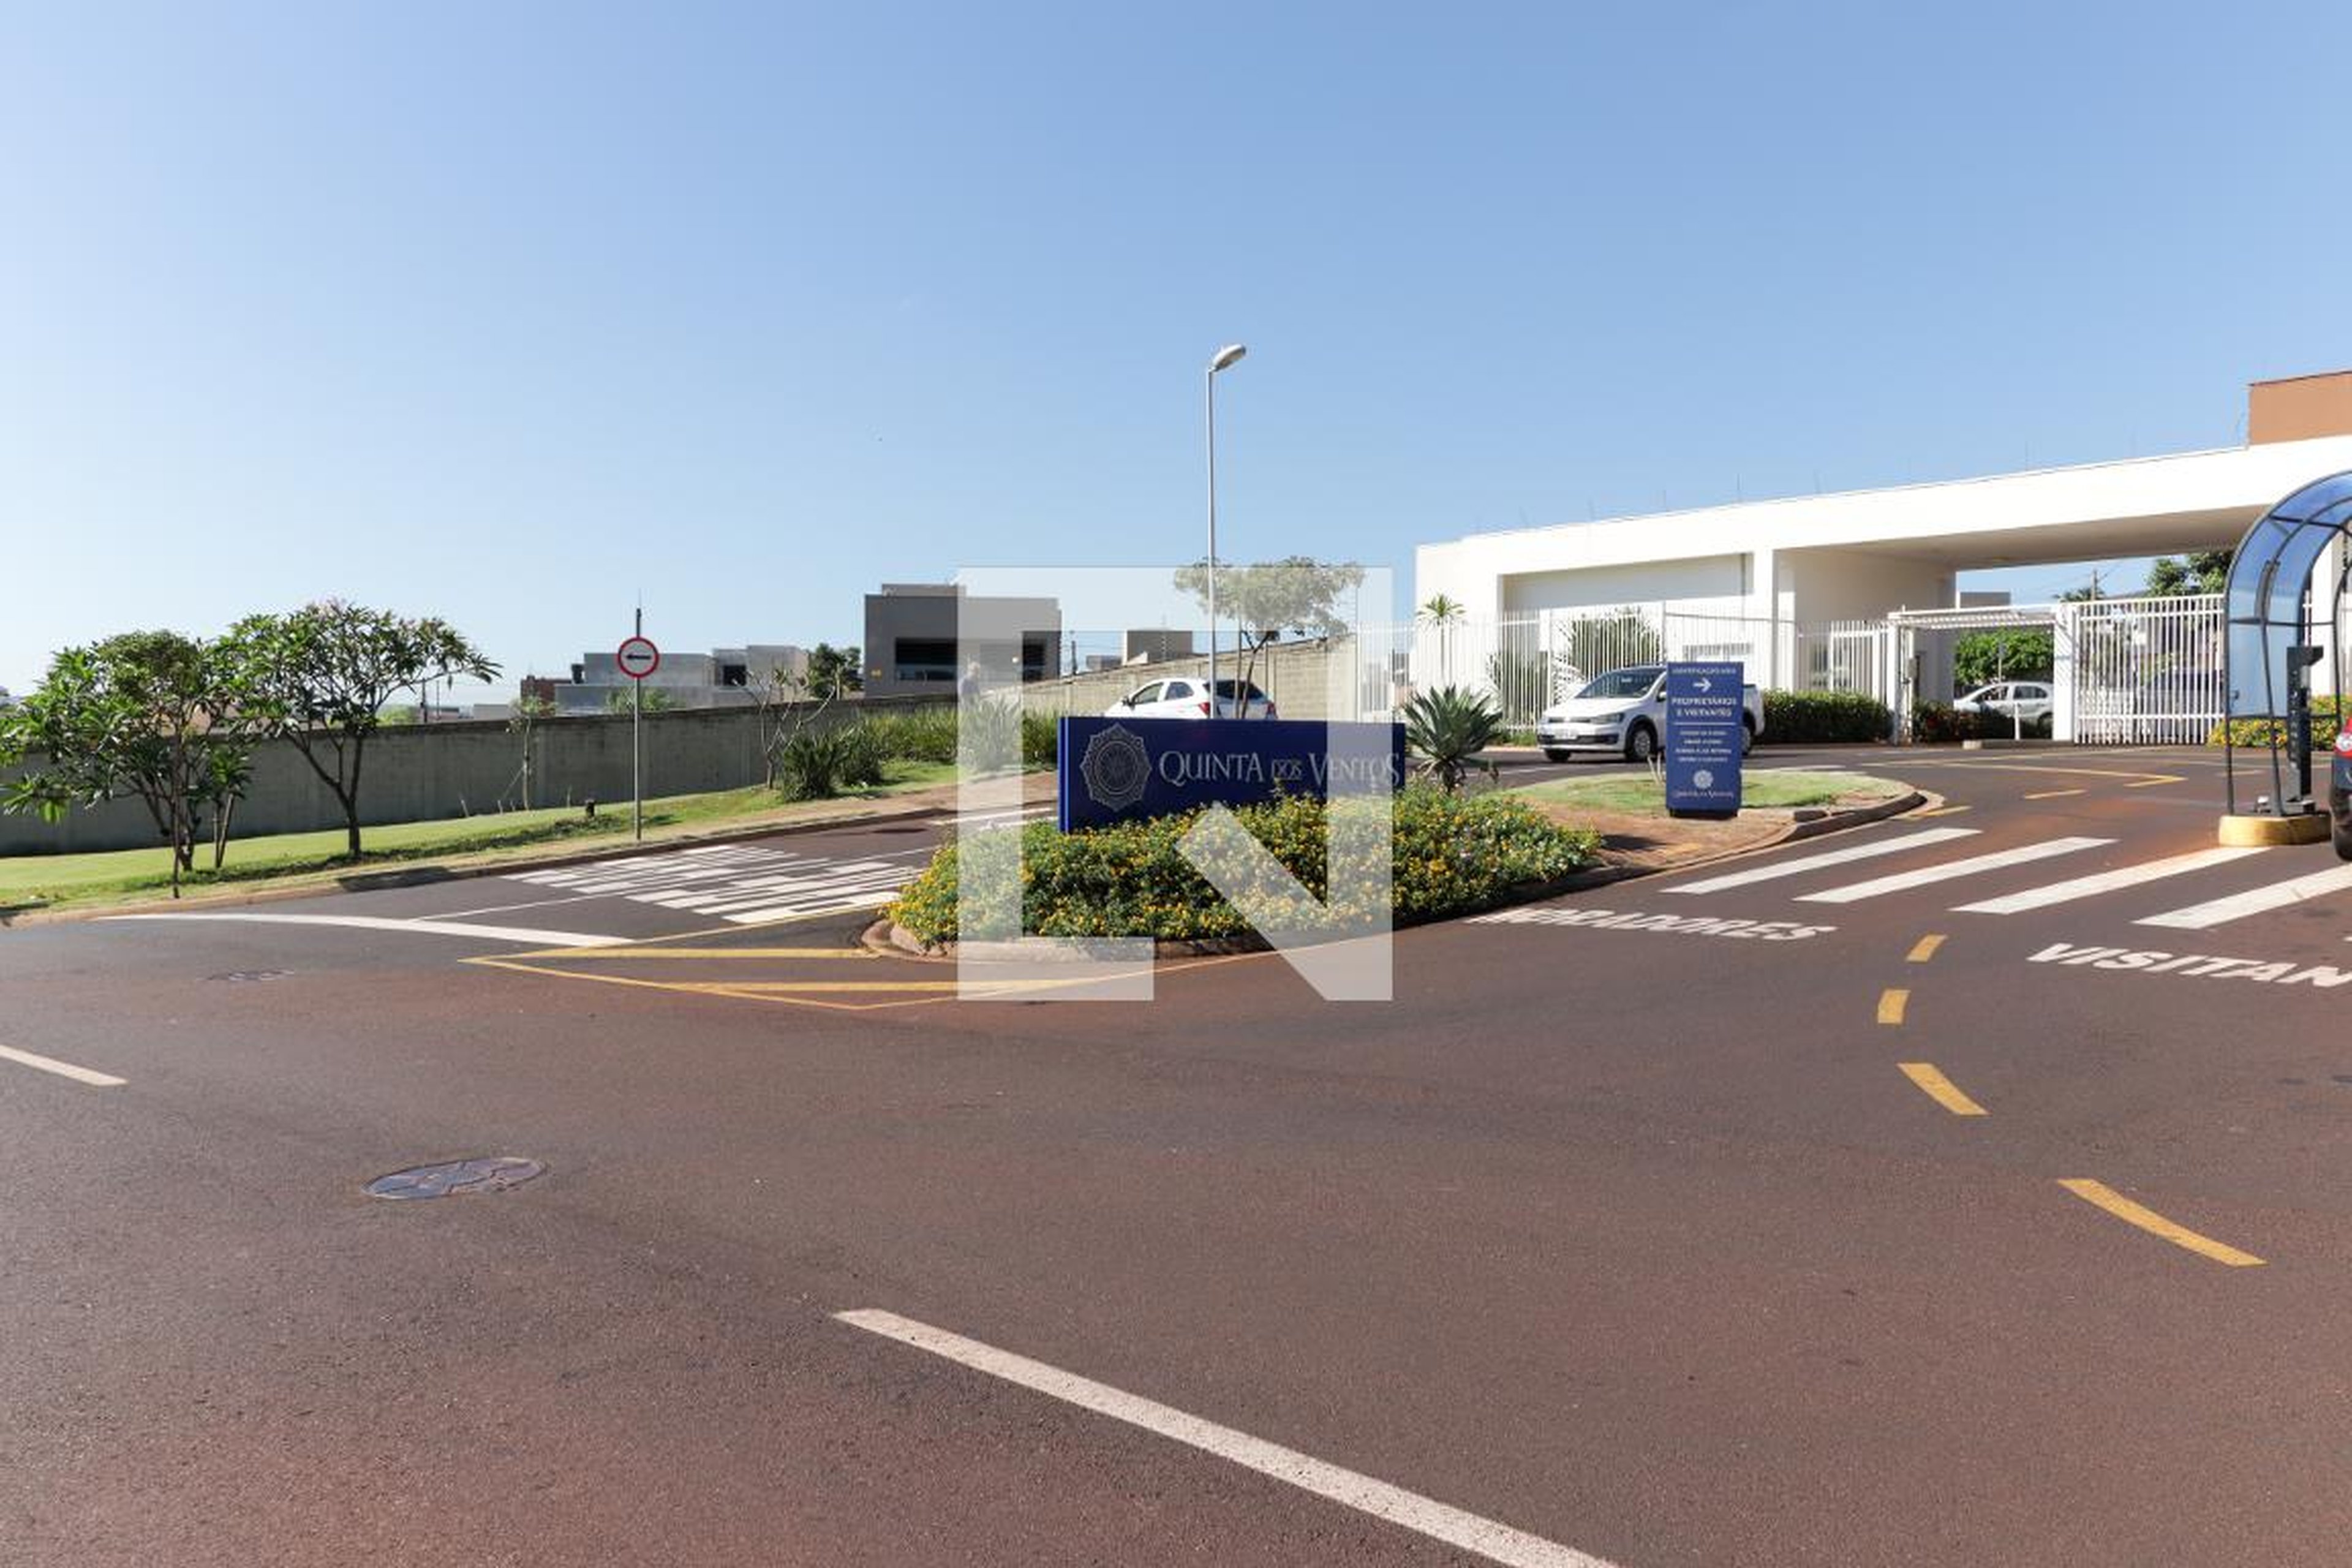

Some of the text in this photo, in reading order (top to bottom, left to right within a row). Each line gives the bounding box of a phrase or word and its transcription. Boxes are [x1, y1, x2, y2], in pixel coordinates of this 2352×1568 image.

[1159, 750, 1265, 787] QUINTA
[1308, 752, 1400, 787] VENTOS
[2026, 943, 2352, 987] VISITAN
